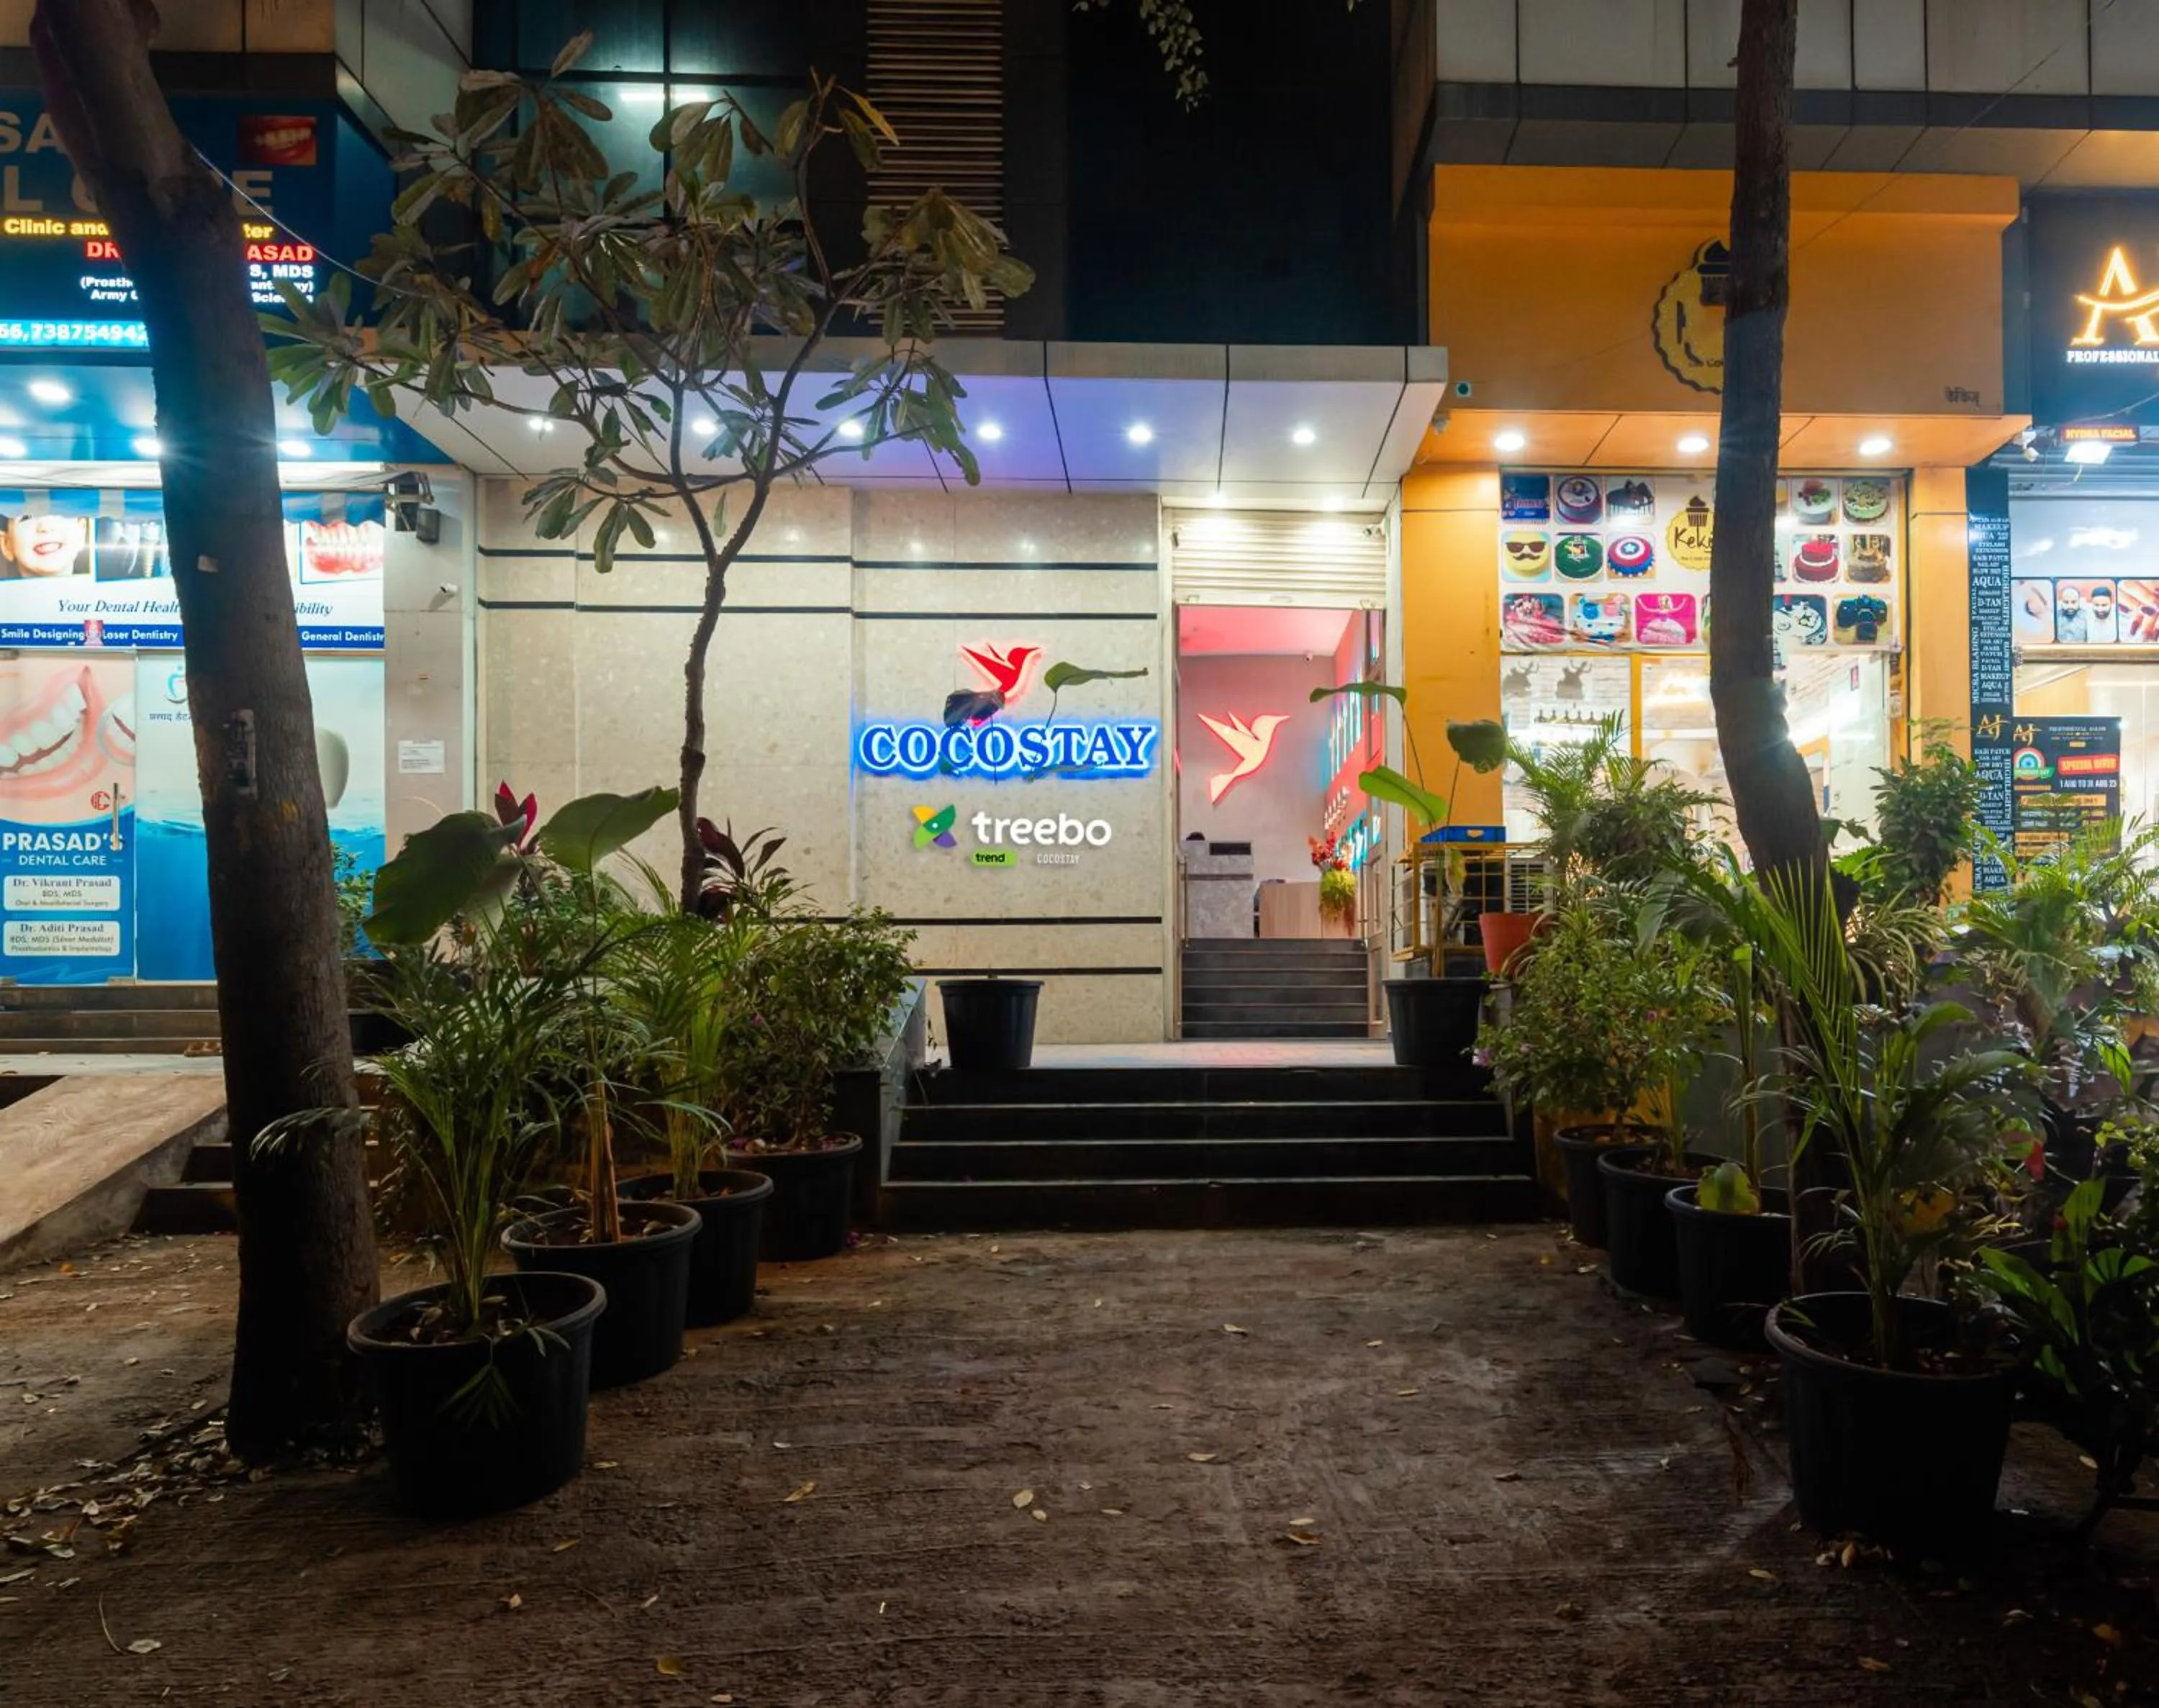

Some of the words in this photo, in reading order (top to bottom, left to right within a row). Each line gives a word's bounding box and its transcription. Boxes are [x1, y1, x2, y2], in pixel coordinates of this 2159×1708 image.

[4, 218, 65, 235] Clinic
[272, 264, 314, 278] MDS
[90, 289, 127, 302] Army
[2101, 430, 2136, 438] FACIAL
[1972, 576, 2001, 588] AQUA
[58, 599, 91, 612] Your
[94, 599, 139, 613] Dental
[143, 600, 180, 612] Healt
[1, 628, 30, 639] Smile
[33, 628, 85, 642] Designing
[103, 630, 128, 639] Laser
[132, 630, 178, 642] Dentistry
[302, 630, 342, 642] General
[860, 724, 1154, 771] COCOSTAY
[972, 811, 1113, 846] treebo
[2, 832, 124, 852] PRASAD'S
[19, 855, 69, 866] DENTAL
[73, 855, 107, 866] CARE
[975, 853, 1005, 863] trend
[13, 878, 30, 888] Dr.
[32, 878, 72, 888] Vikrant
[76, 878, 112, 888] Prasad
[20, 923, 36, 934] Dr.
[39, 923, 65, 933] Aditi
[68, 923, 104, 933] Prasad
